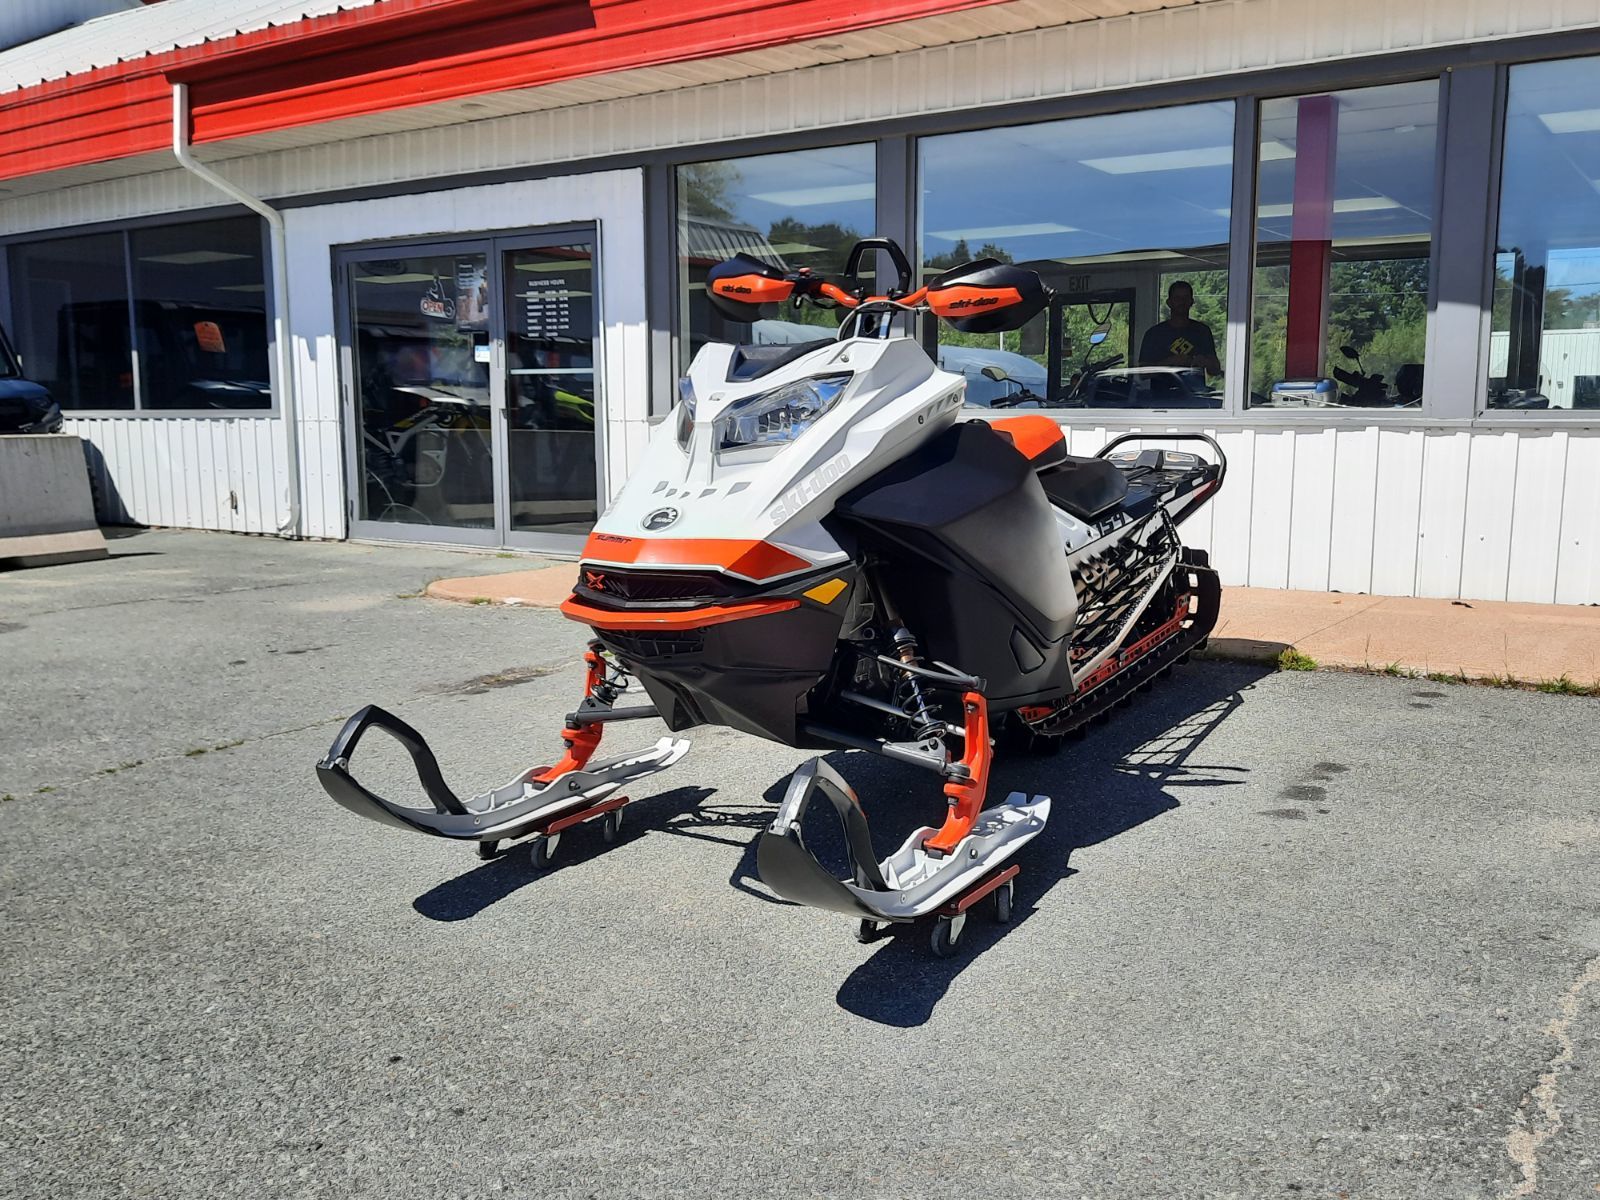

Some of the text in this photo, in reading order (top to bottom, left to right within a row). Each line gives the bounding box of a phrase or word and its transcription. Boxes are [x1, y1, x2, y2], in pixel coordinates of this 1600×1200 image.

[1069, 274, 1090, 290] EXIT
[422, 300, 444, 313] OPEN
[948, 297, 999, 309] ski-doo
[594, 534, 632, 545] SUMMIT
